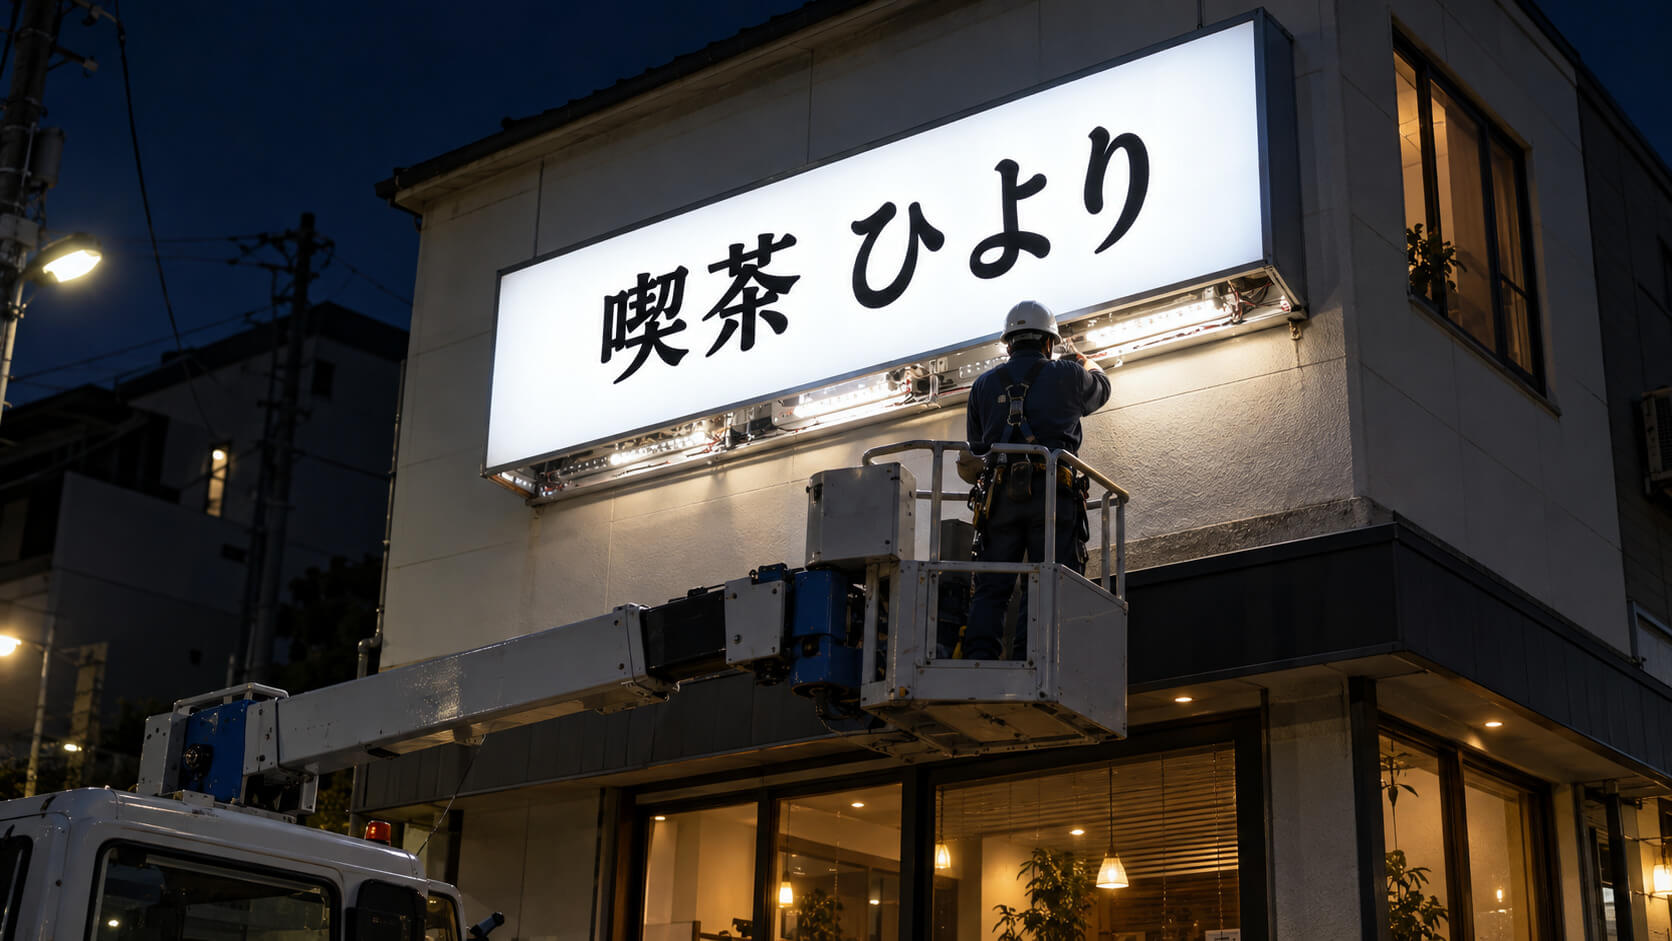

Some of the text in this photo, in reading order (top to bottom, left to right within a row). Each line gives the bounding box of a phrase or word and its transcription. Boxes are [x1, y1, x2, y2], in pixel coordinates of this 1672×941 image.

[601, 127, 1149, 384] 喫茶 ひより
